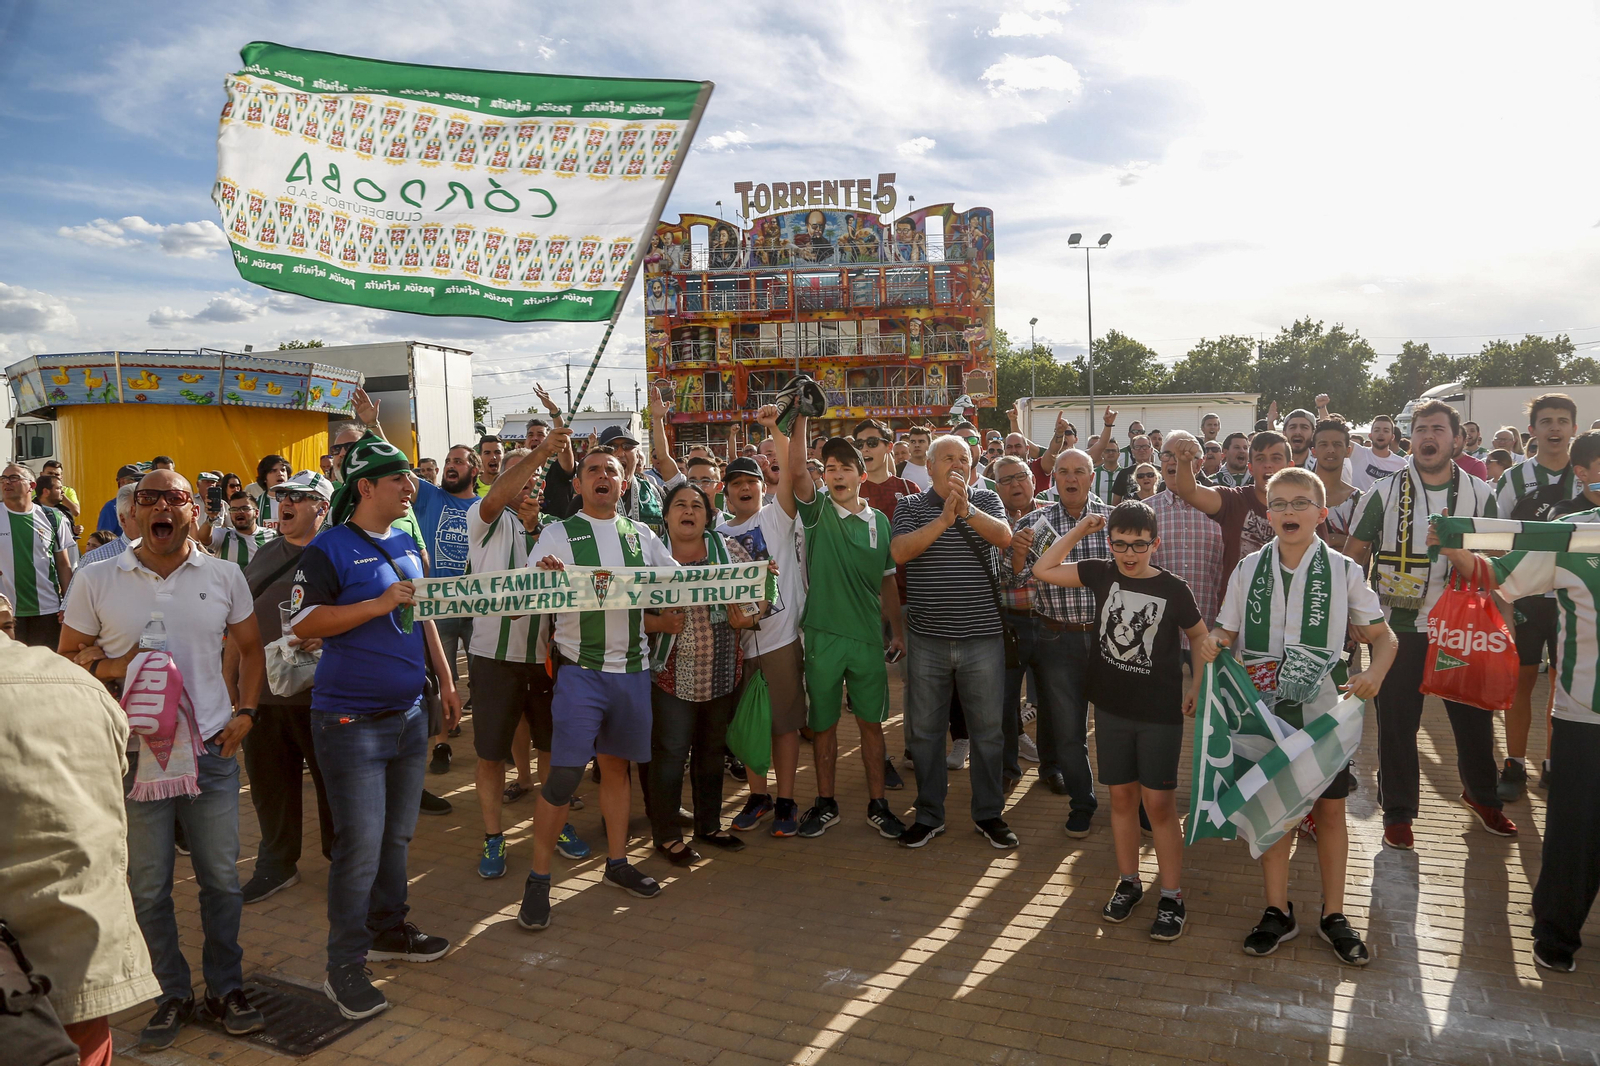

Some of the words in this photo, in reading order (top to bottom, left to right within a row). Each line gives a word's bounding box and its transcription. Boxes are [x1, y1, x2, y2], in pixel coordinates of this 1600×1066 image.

[733, 178, 872, 219] TORRENTE
[875, 172, 897, 214] 5
[566, 534, 591, 543] Kappa
[353, 557, 378, 565] Kappa
[427, 576, 483, 599] PEÑA
[490, 571, 571, 594] FAMILIA
[634, 571, 662, 585] EL
[669, 566, 760, 584] ABUELO
[419, 591, 578, 617] BLANQUIVERDE
[627, 591, 642, 606] Y
[650, 589, 680, 605] SU
[687, 584, 763, 603] TRUPE
[1308, 579, 1329, 627] infinita
